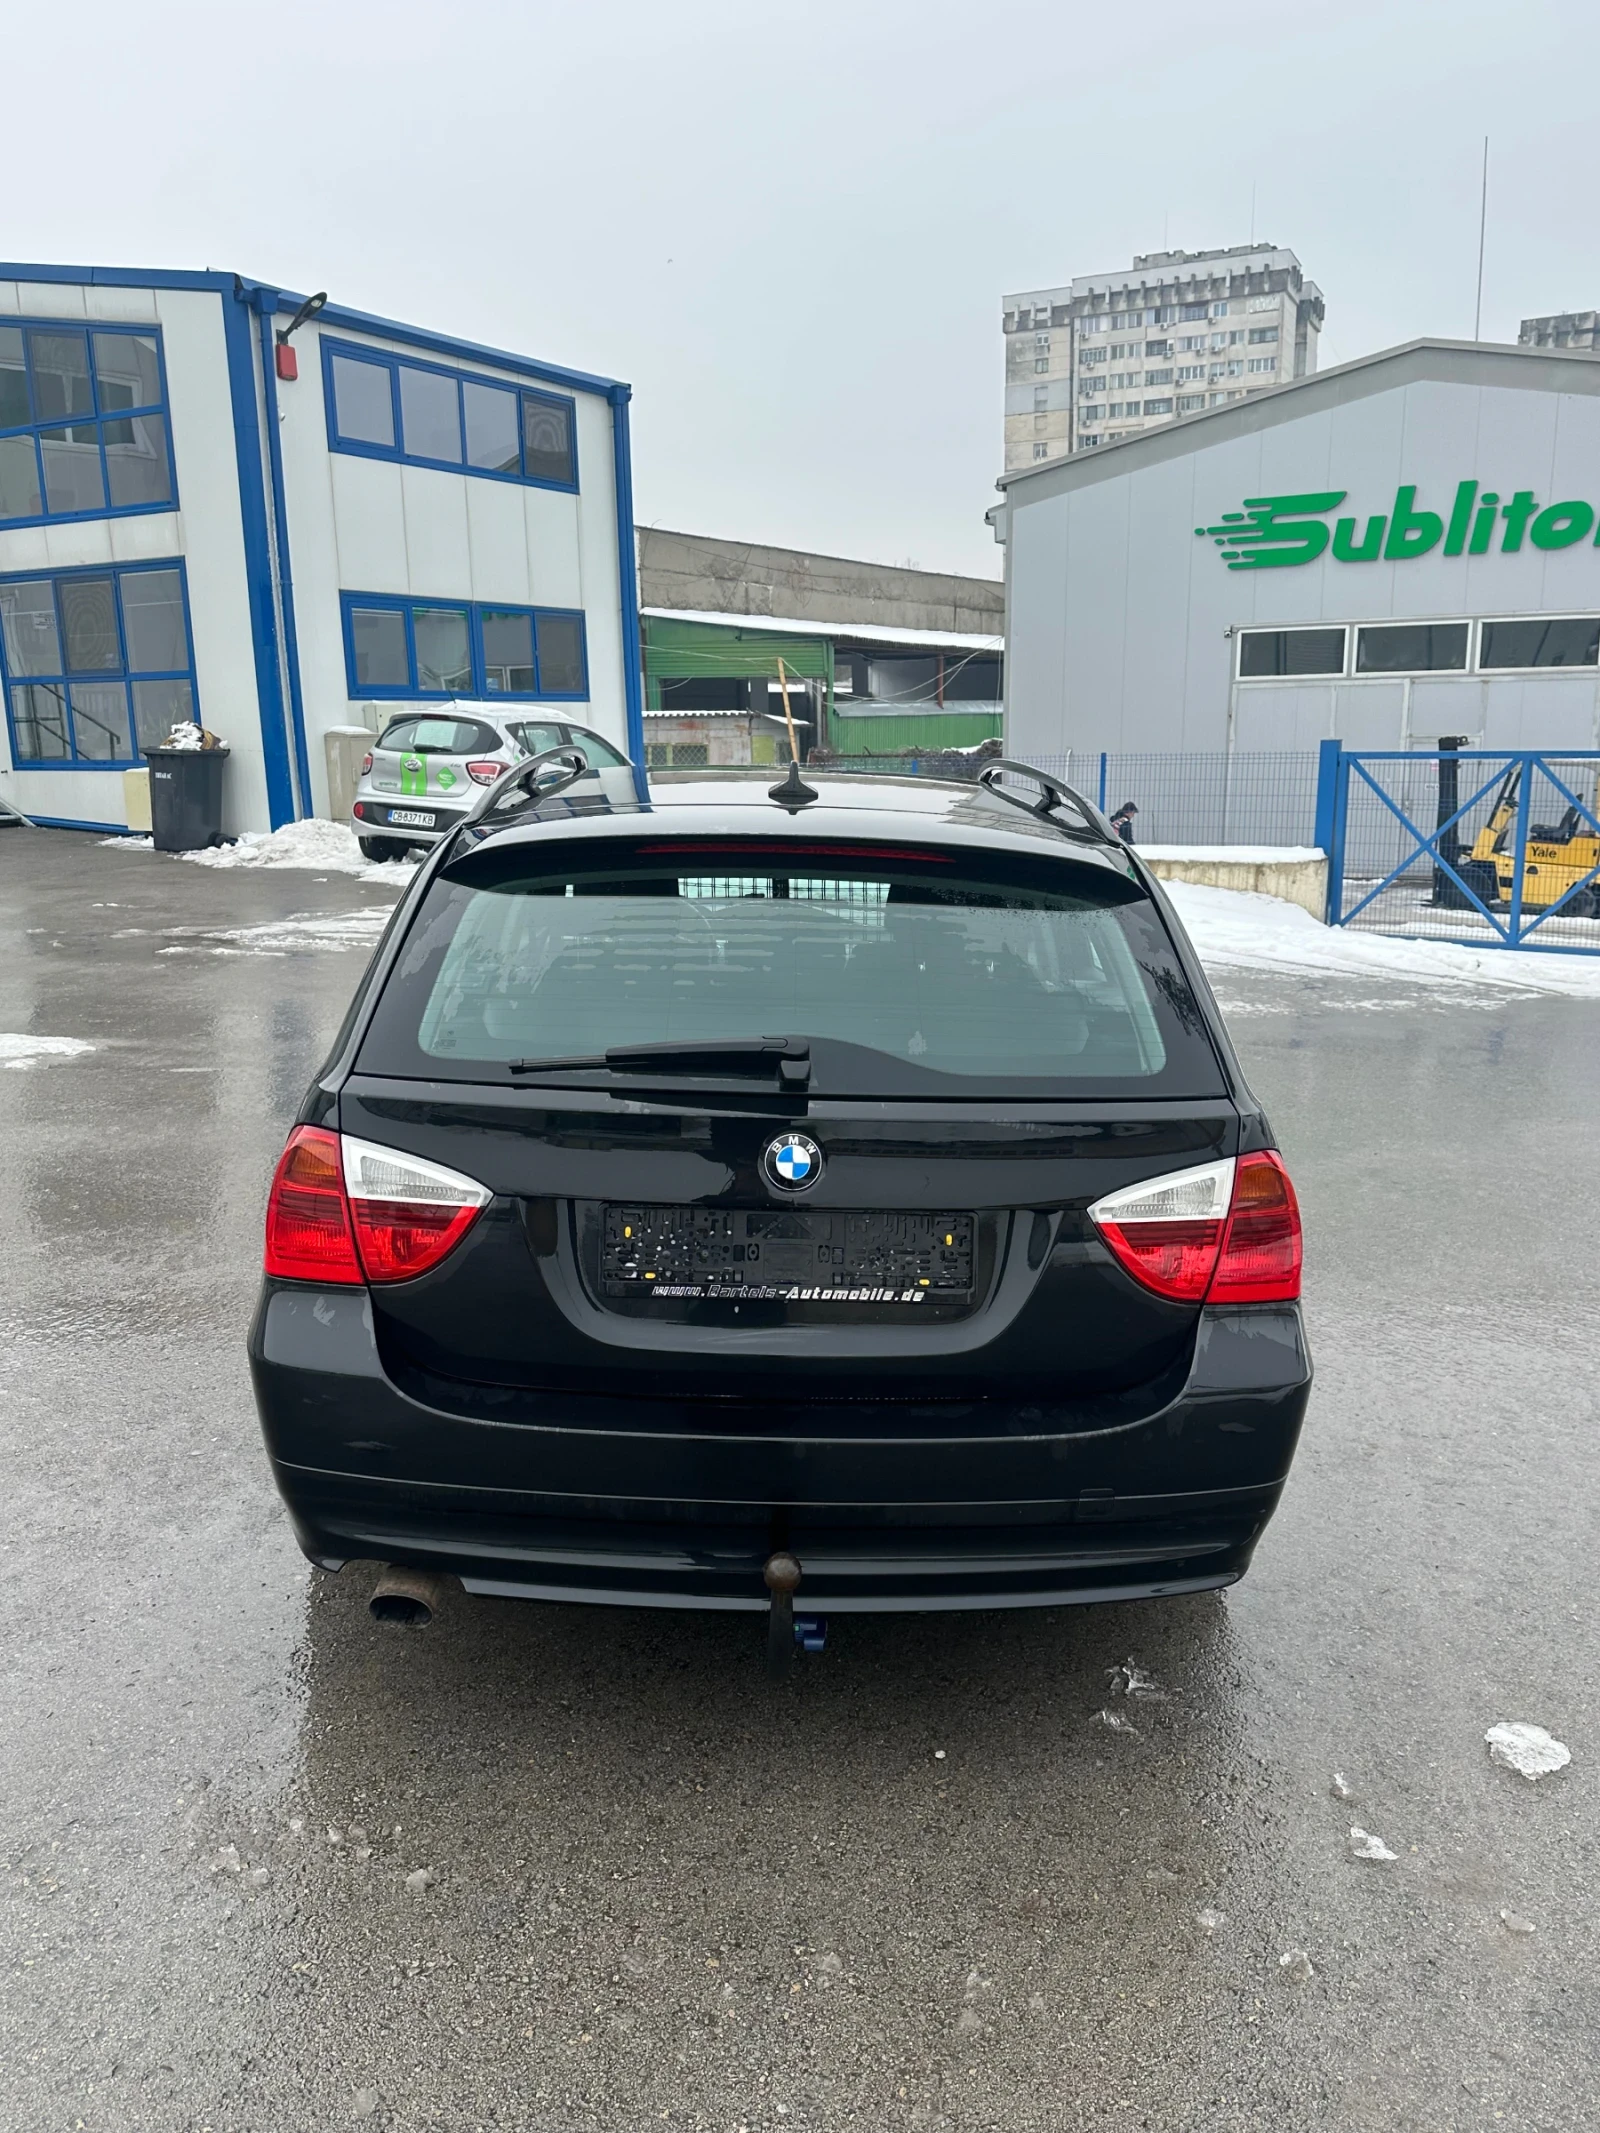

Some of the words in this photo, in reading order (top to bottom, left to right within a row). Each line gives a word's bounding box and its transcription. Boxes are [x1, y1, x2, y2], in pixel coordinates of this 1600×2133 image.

[1196, 480, 1600, 570] Sublito
[1531, 846, 1557, 859] Yale
[771, 1136, 817, 1154] BMW
